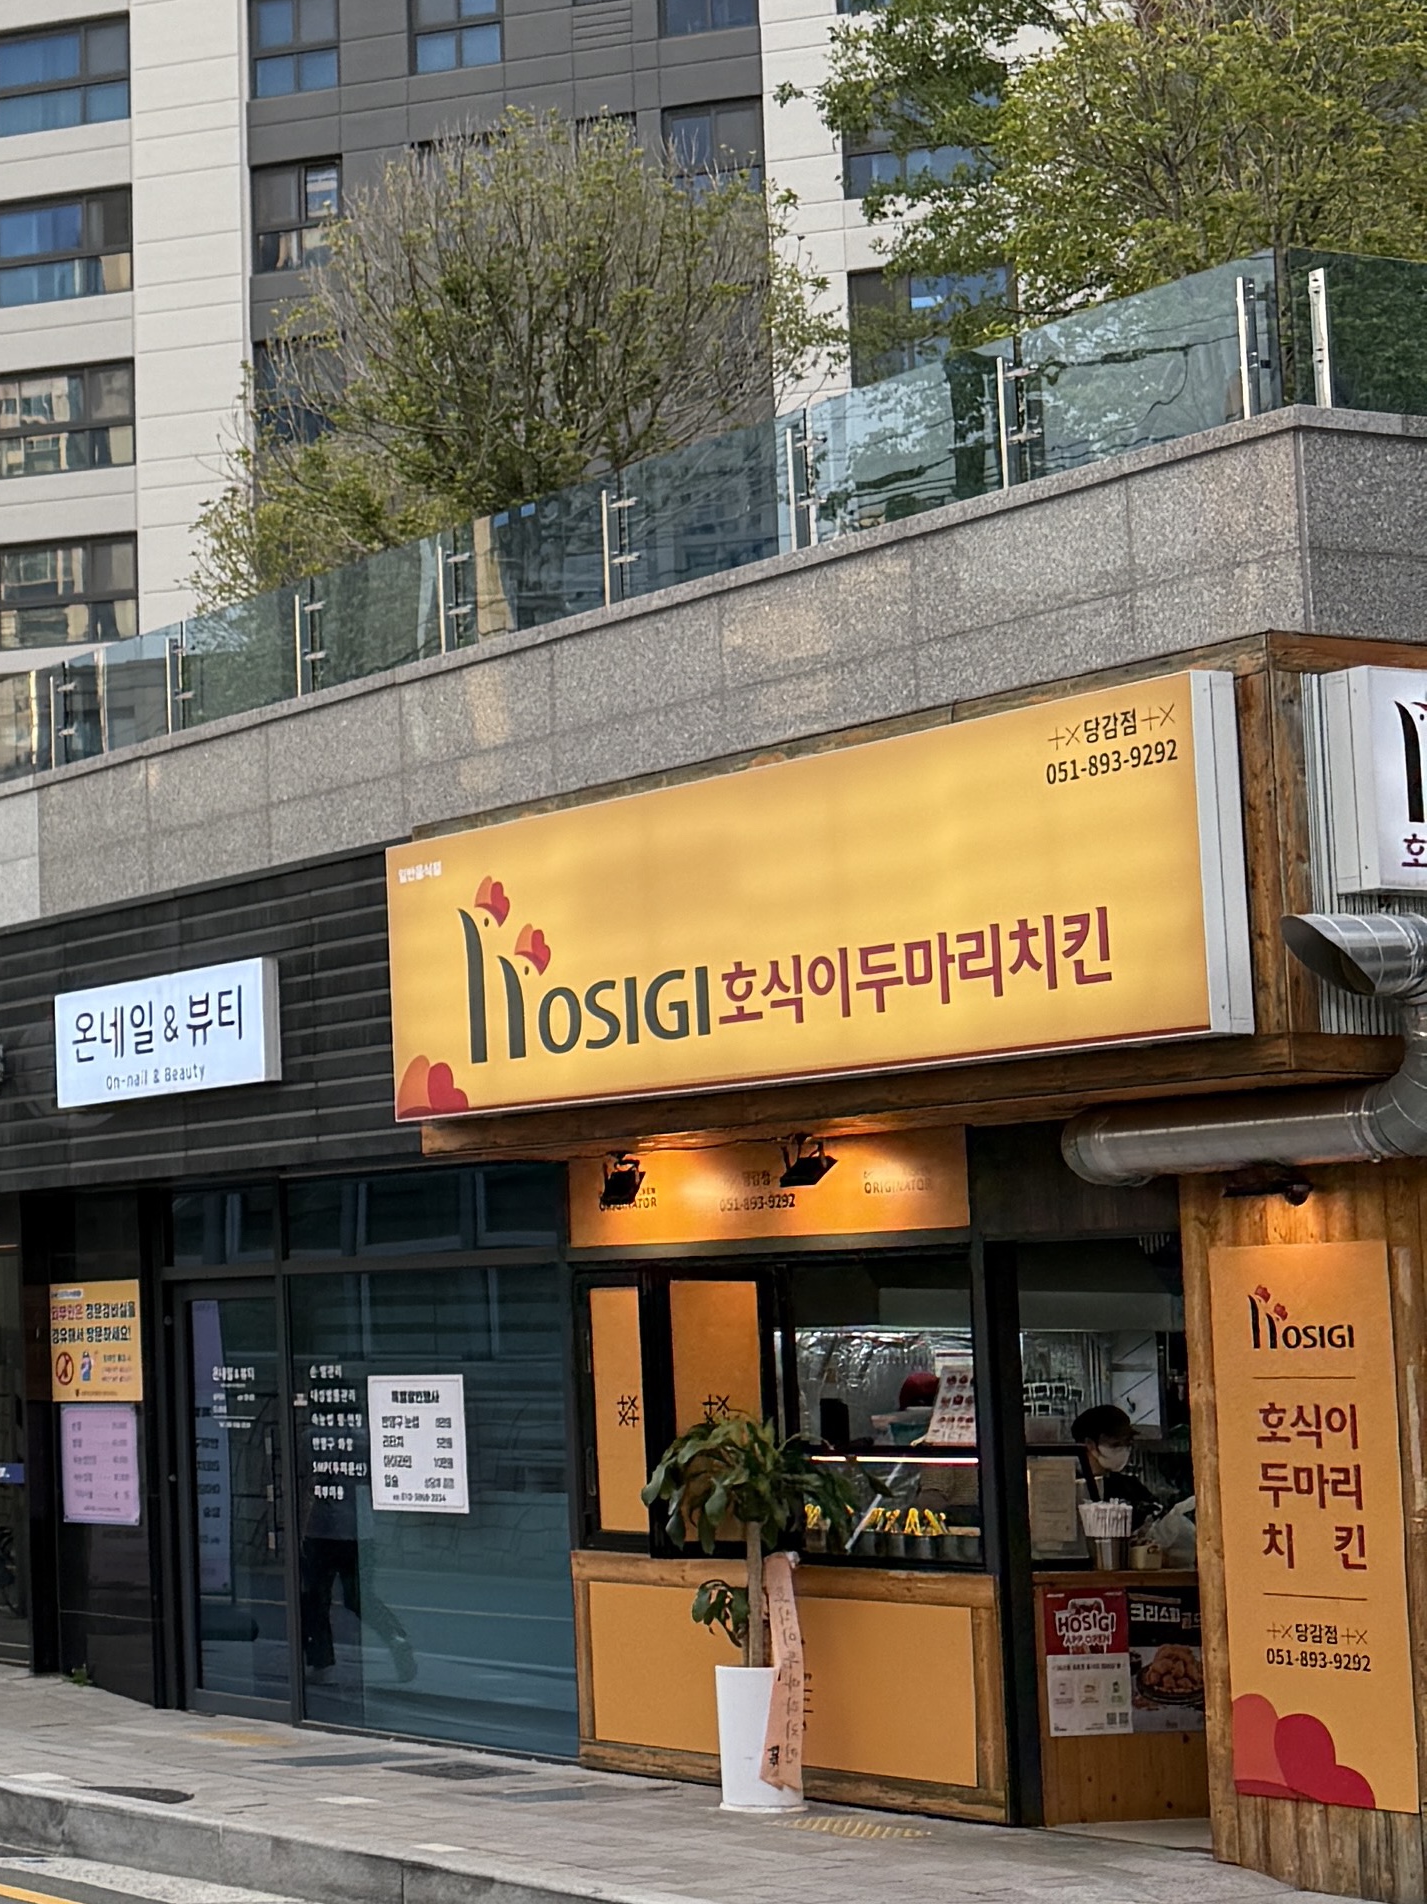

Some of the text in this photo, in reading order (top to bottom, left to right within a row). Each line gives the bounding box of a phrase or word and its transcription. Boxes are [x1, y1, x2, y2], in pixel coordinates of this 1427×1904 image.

[1083, 708, 1138, 745] 당감점
[1046, 738, 1178, 786] 051-893-9292
[718, 906, 1113, 1025] 호식이두마리치킨
[72, 984, 243, 1062] 온네일 & 뷰티
[106, 1064, 205, 1090] On-nail & Beauty
[719, 1193, 796, 1212] 051-893-9292
[1248, 1295, 1354, 1349] HOSIGI
[1257, 1402, 1358, 1450] 호식이
[1259, 1463, 1363, 1511] 두마리
[1058, 1611, 1116, 1634] HOSIGI
[1085, 1634, 1111, 1645] OPEN
[1295, 1623, 1338, 1645] 당감점
[1266, 1649, 1371, 1672] 051-893-9292
